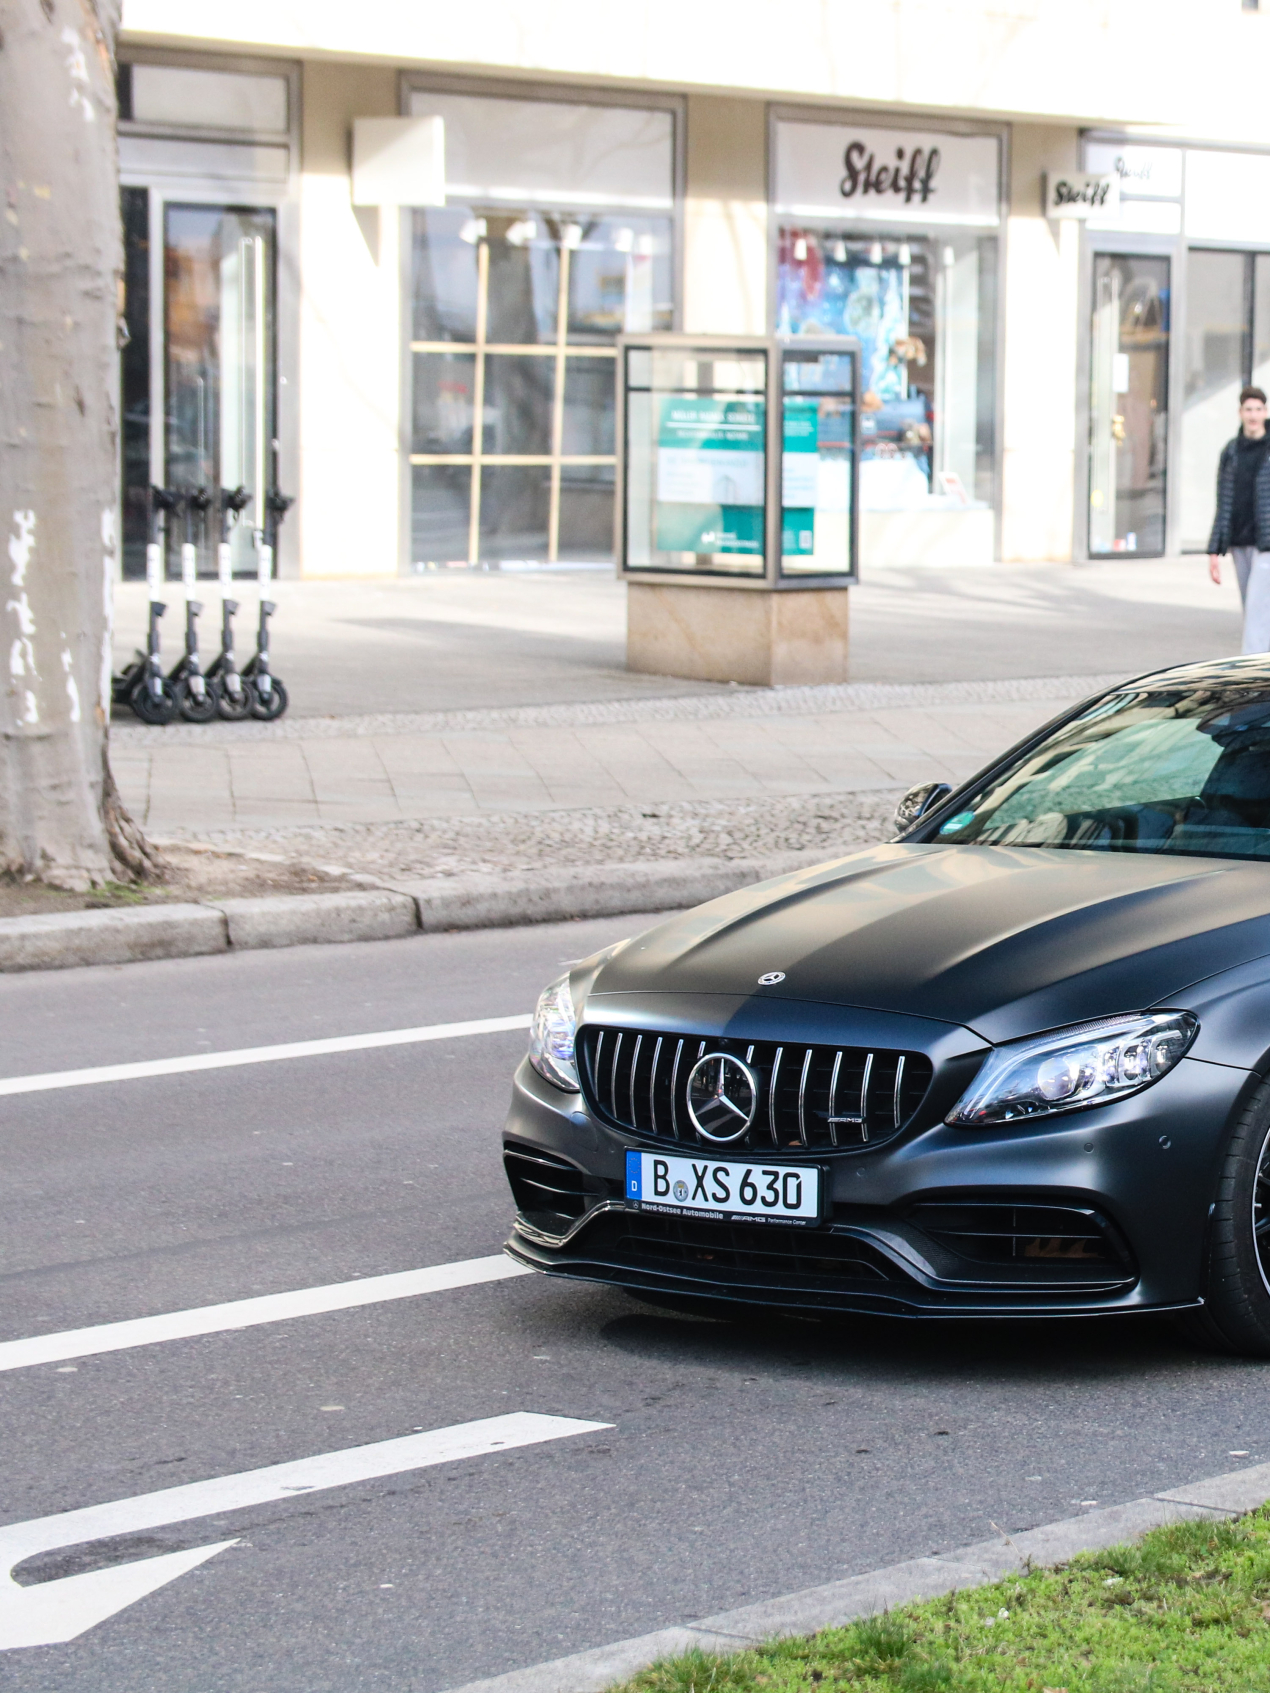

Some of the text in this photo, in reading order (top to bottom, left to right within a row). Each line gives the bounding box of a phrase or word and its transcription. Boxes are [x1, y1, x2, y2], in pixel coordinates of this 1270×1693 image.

[841, 141, 940, 203] Steiff
[1054, 181, 1109, 206] Steiff
[631, 1180, 638, 1191] D
[653, 1159, 802, 1210] B XS 630
[641, 1203, 681, 1215] Nord-Ostsee
[682, 1208, 724, 1219] Automobile
[767, 1217, 793, 1225] Performance
